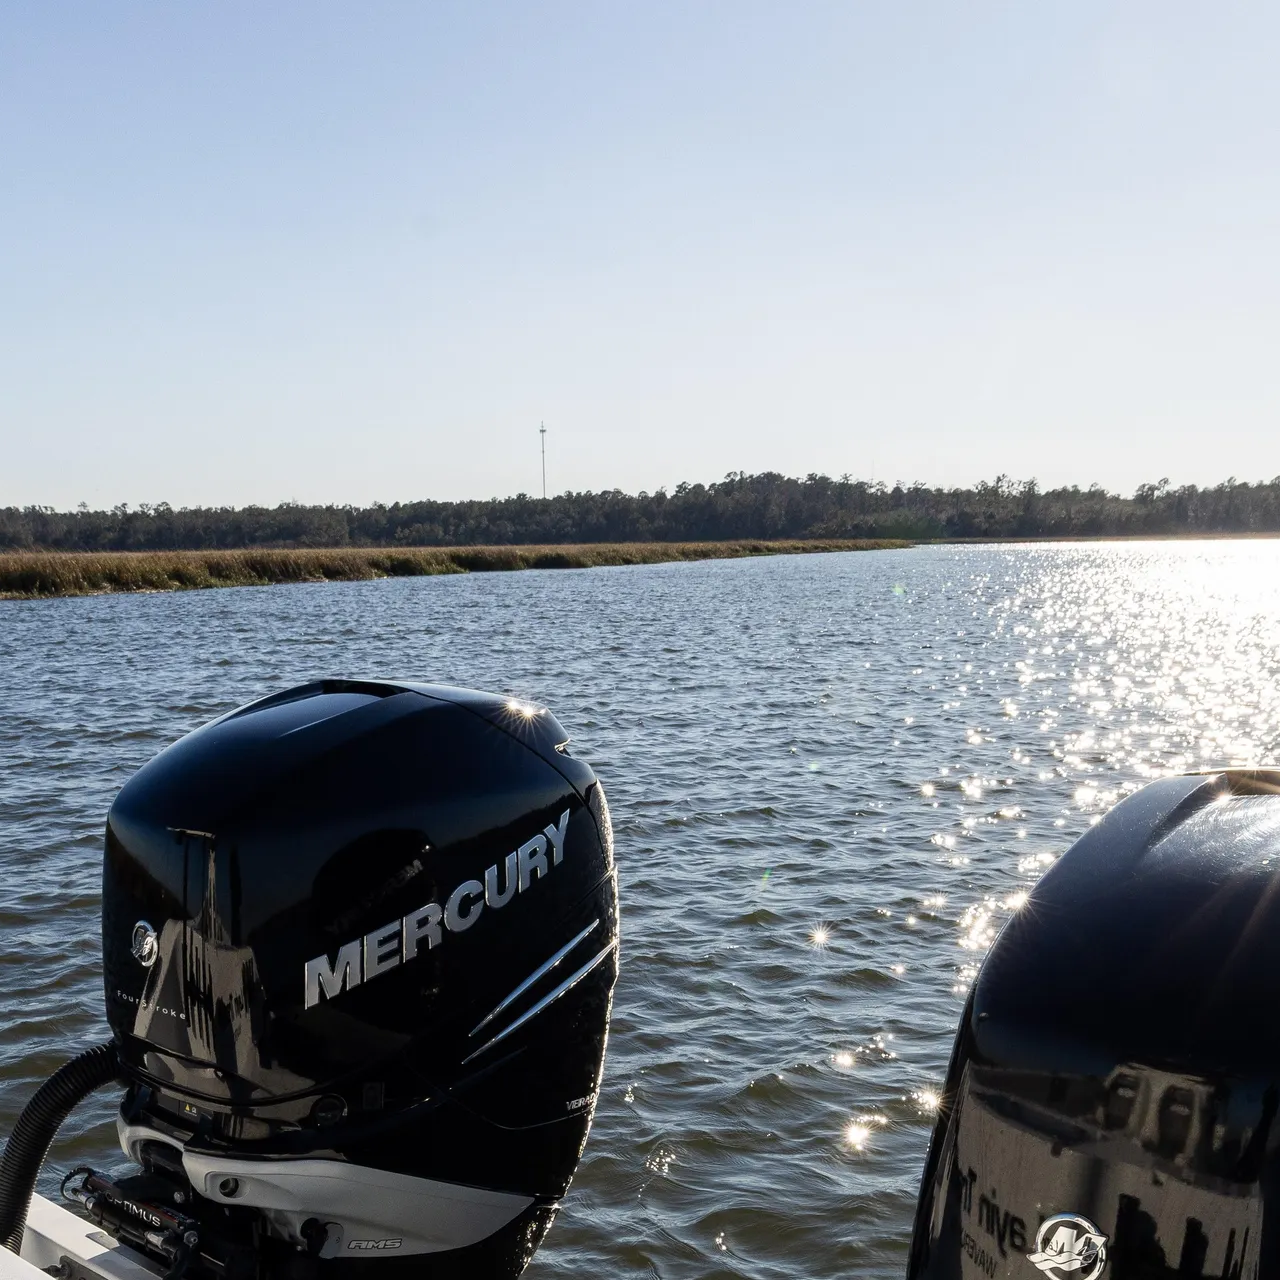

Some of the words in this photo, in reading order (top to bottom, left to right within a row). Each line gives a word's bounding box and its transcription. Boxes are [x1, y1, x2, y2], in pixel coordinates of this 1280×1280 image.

[305, 808, 570, 1010] MERCURY
[117, 989, 186, 1020] FourStroke
[347, 1238, 402, 1250] AMS
